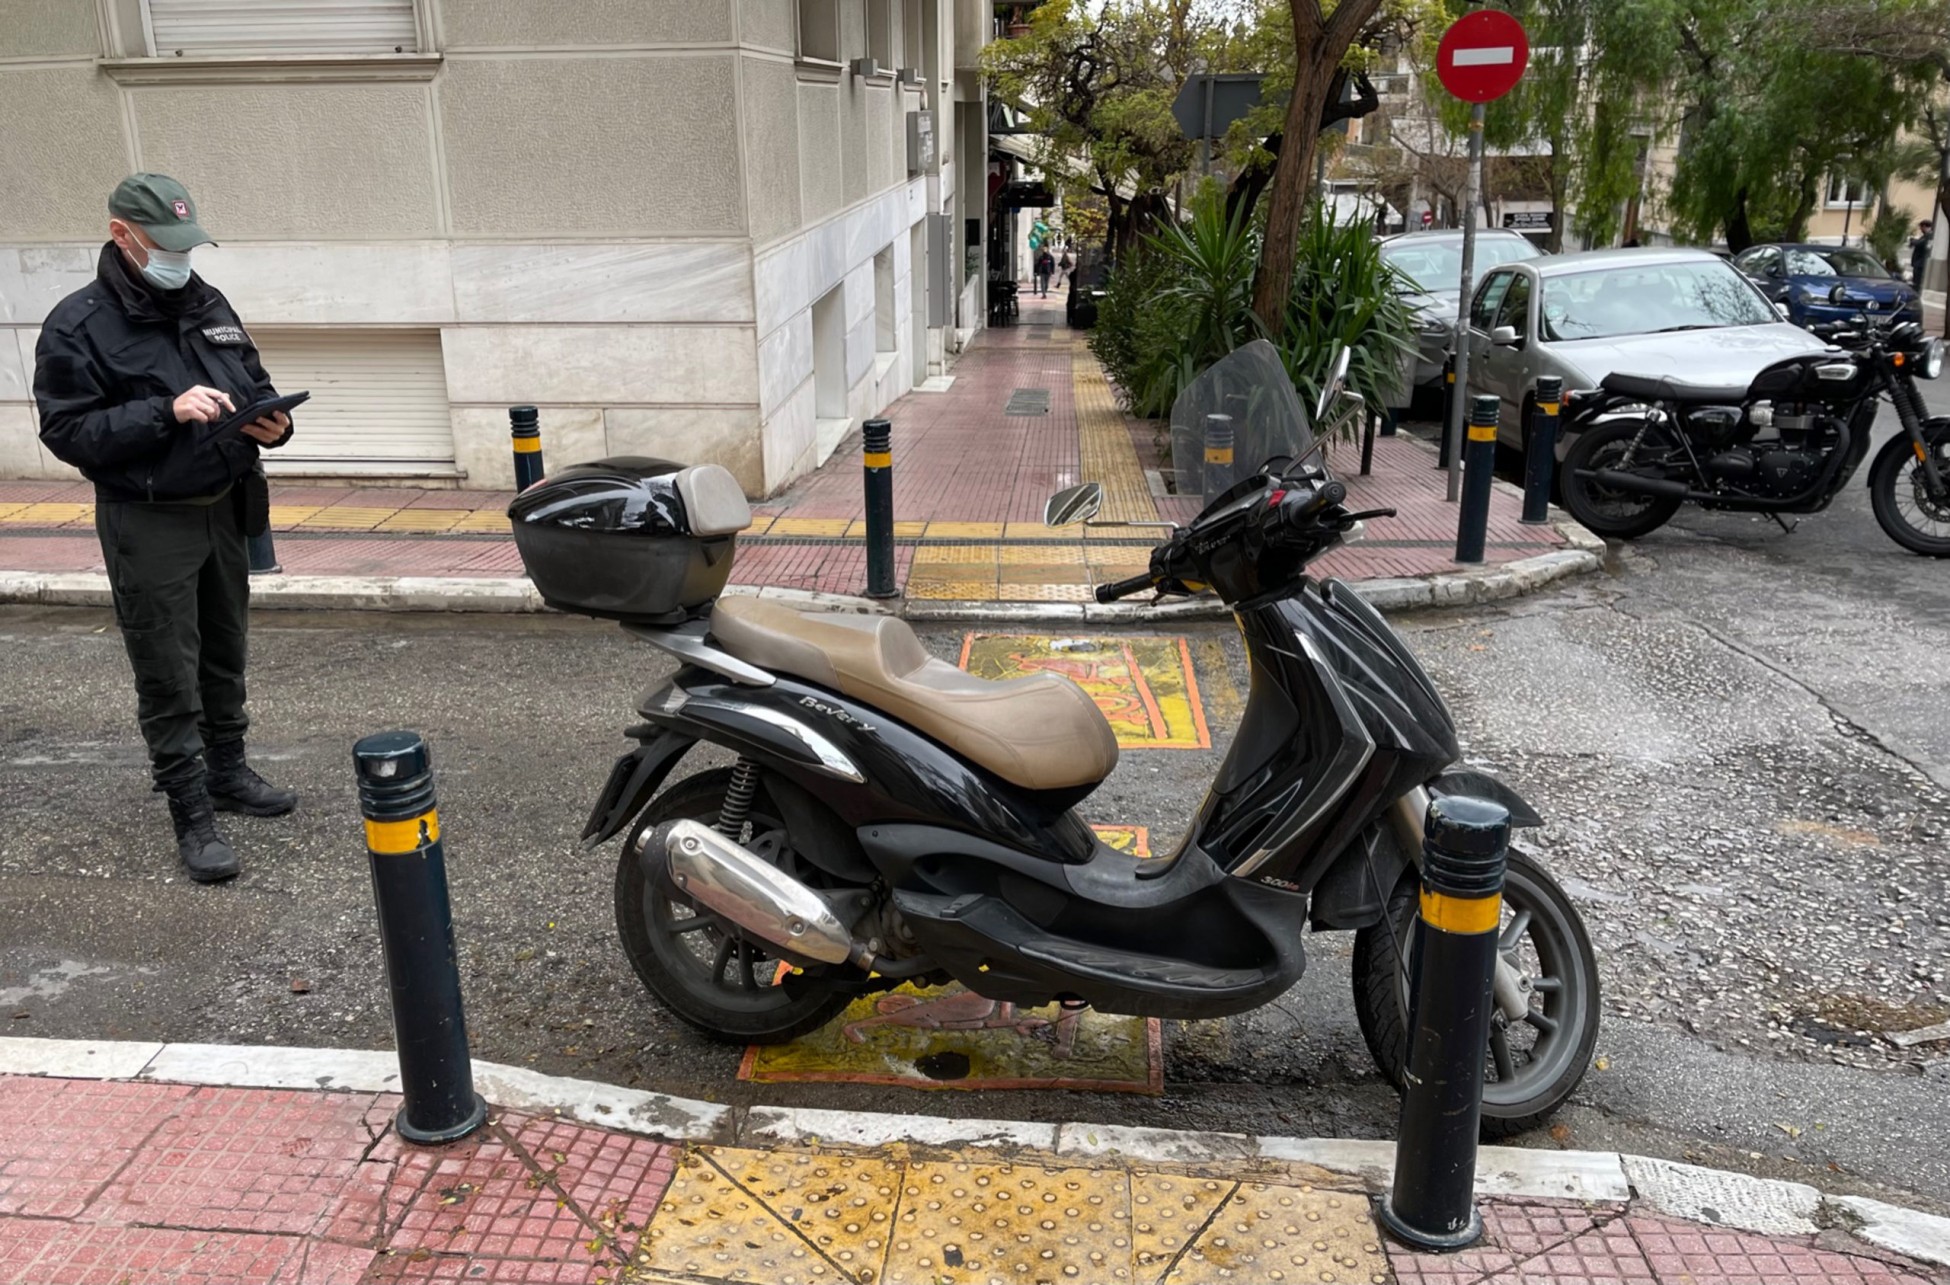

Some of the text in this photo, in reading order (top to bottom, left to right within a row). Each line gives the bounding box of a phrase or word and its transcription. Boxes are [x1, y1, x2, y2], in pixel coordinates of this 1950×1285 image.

[202, 326, 242, 336] MUNICIPAL
[214, 333, 241, 342] POLICE
[799, 696, 876, 731] Bevery
